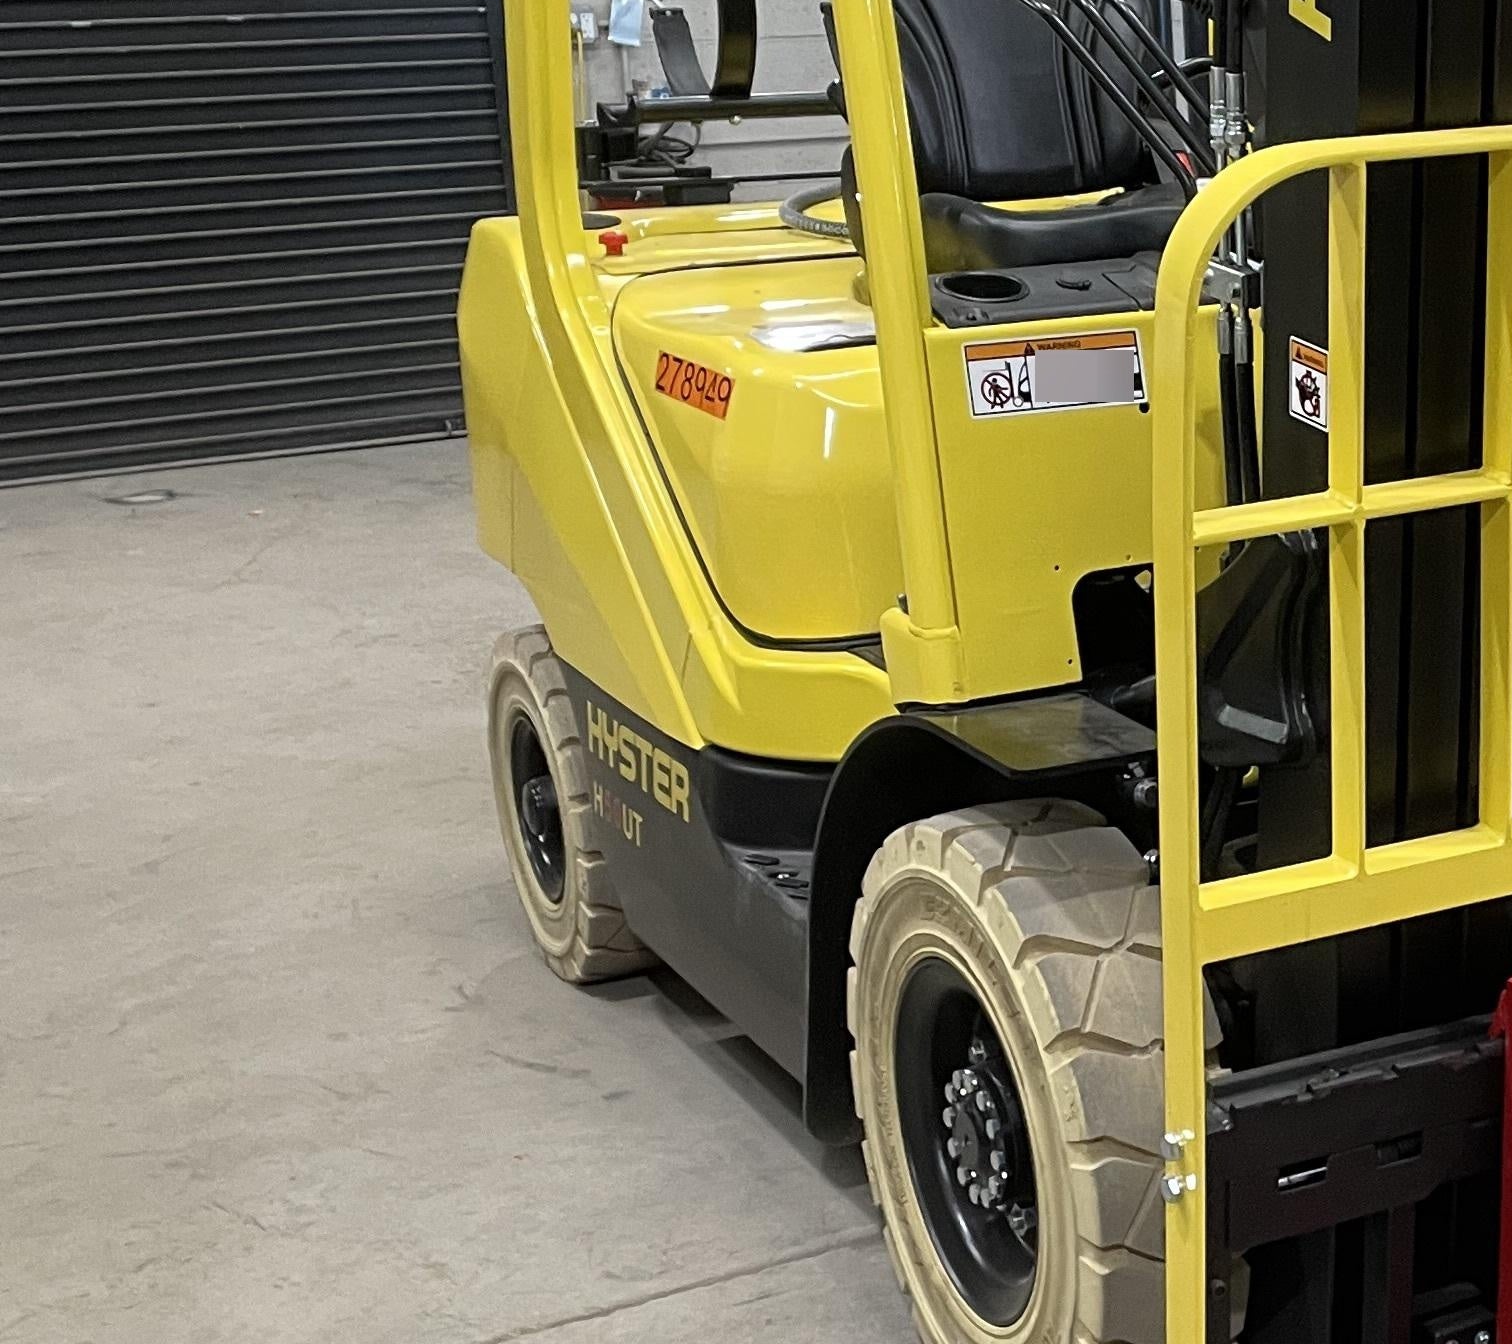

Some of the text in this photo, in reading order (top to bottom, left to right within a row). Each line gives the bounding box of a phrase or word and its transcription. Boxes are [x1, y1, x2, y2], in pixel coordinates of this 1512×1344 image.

[1036, 339, 1082, 351] WARNING
[656, 352, 731, 418] 278949
[587, 700, 690, 824] HYSTER
